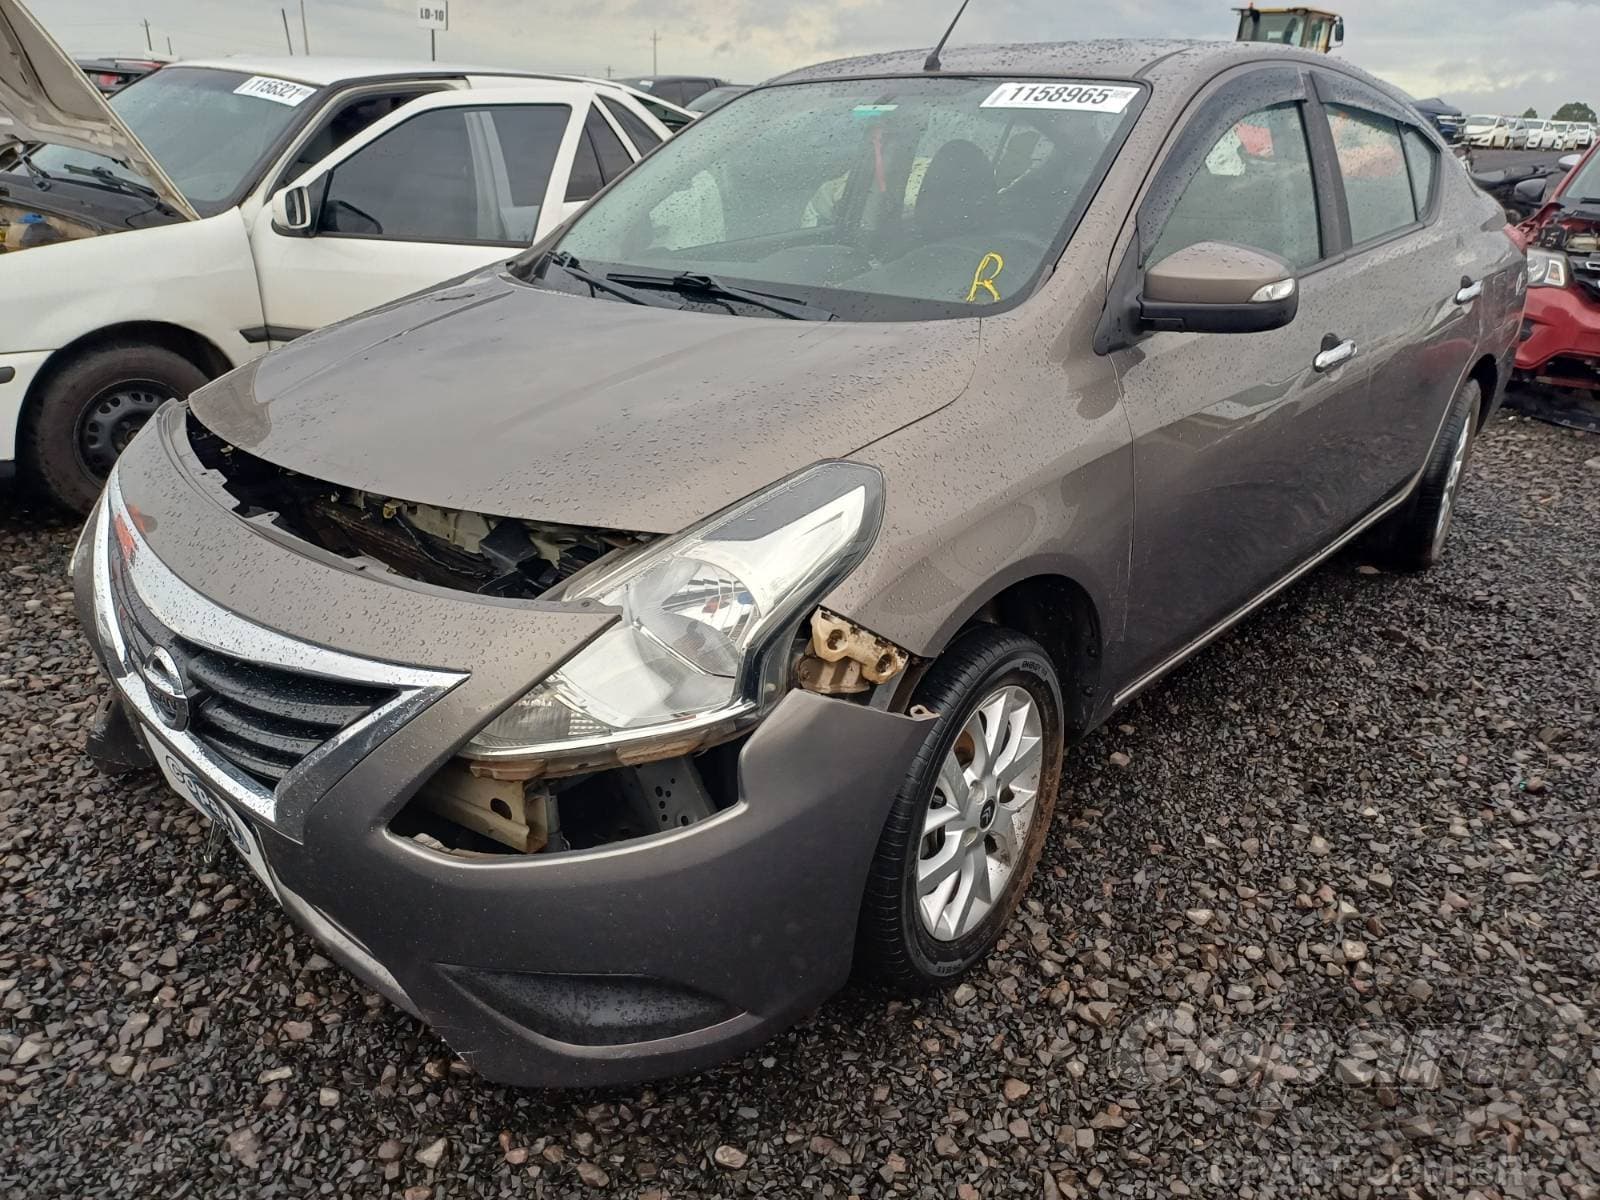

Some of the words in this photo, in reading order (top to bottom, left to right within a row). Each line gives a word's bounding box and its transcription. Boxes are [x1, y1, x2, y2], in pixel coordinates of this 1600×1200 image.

[420, 8, 444, 21] LD-10
[1008, 86, 1114, 105] 1158965
[966, 252, 1004, 303] R
